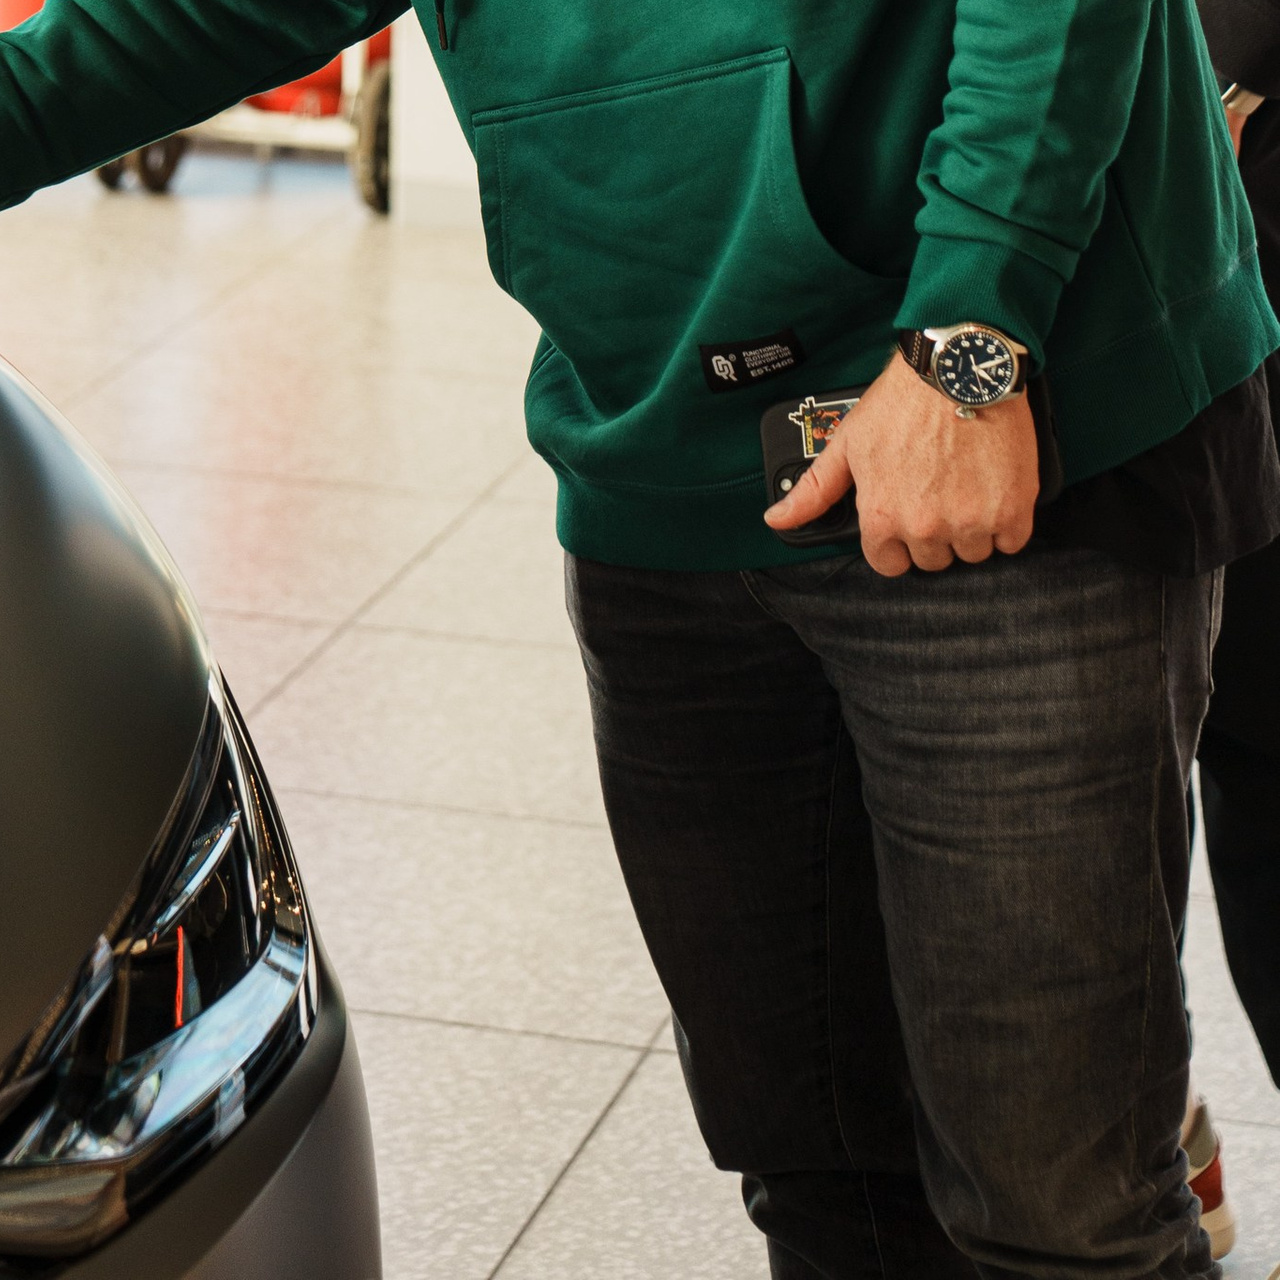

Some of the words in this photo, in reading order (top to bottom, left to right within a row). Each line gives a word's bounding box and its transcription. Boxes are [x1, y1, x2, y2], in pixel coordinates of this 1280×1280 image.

[742, 343, 781, 357] FUNCTIONAL
[744, 350, 776, 363] CLOTHING
[746, 355, 779, 368] EVERYDAY
